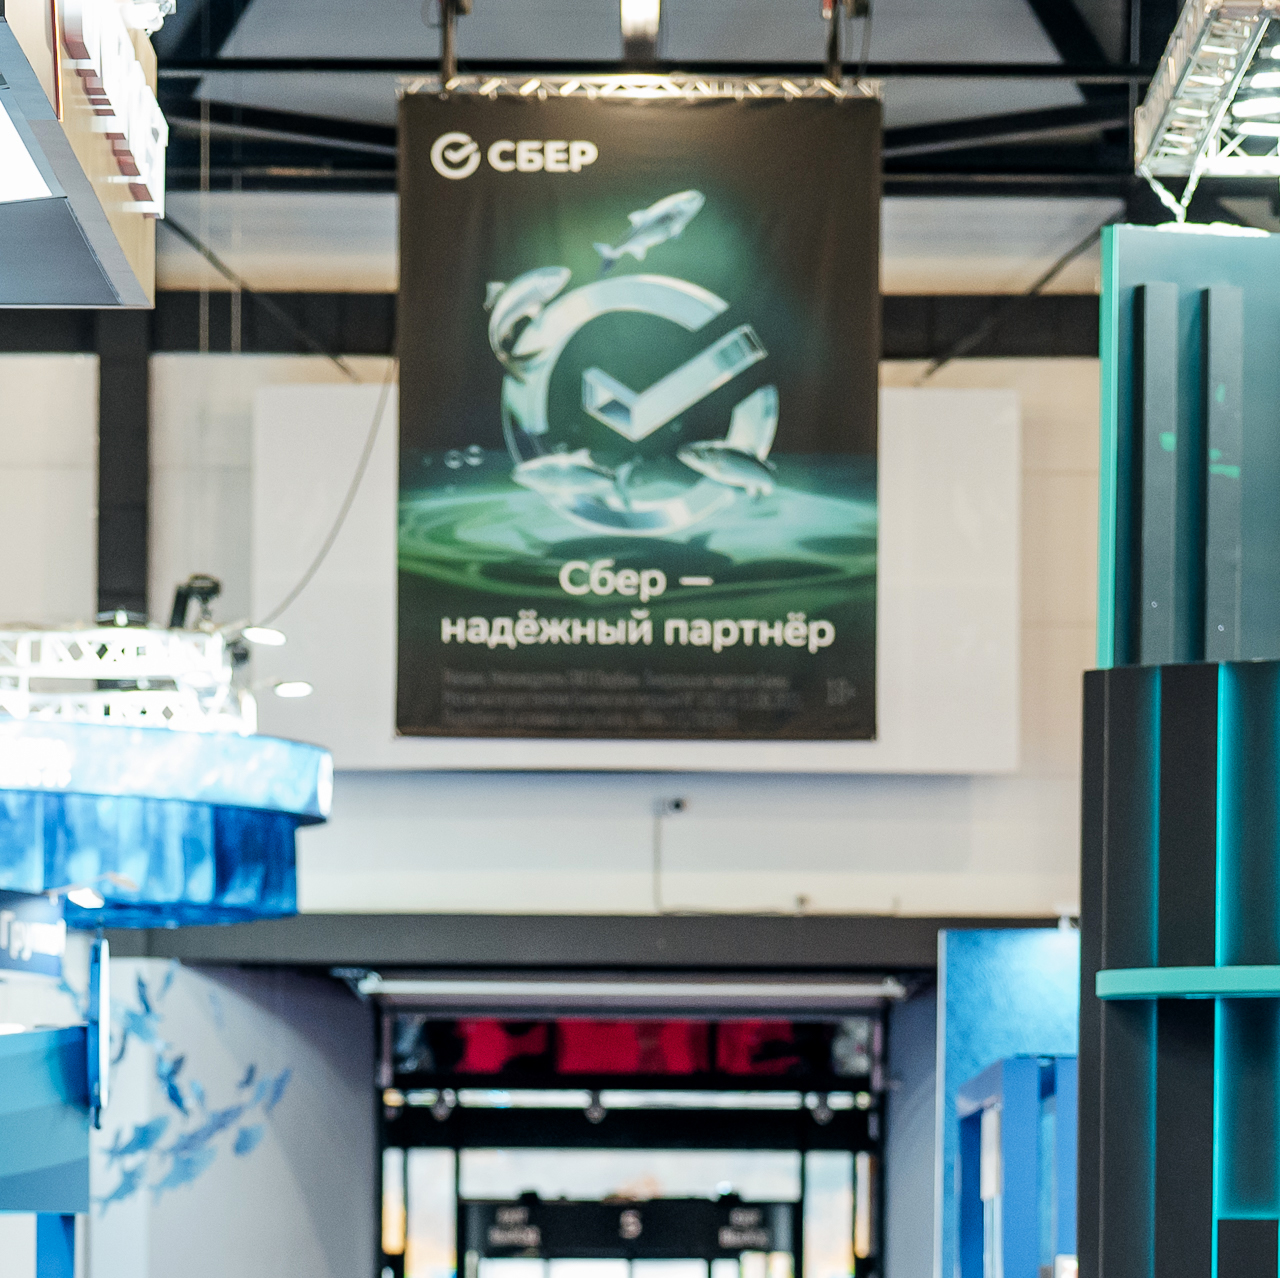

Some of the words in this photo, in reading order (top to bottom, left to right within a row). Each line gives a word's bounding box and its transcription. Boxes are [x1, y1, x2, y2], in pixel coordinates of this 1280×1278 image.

[487, 140, 599, 173] СБЕР
[558, 559, 668, 603] Сбер
[440, 610, 653, 649] надёжный
[663, 612, 836, 654] партнёр
